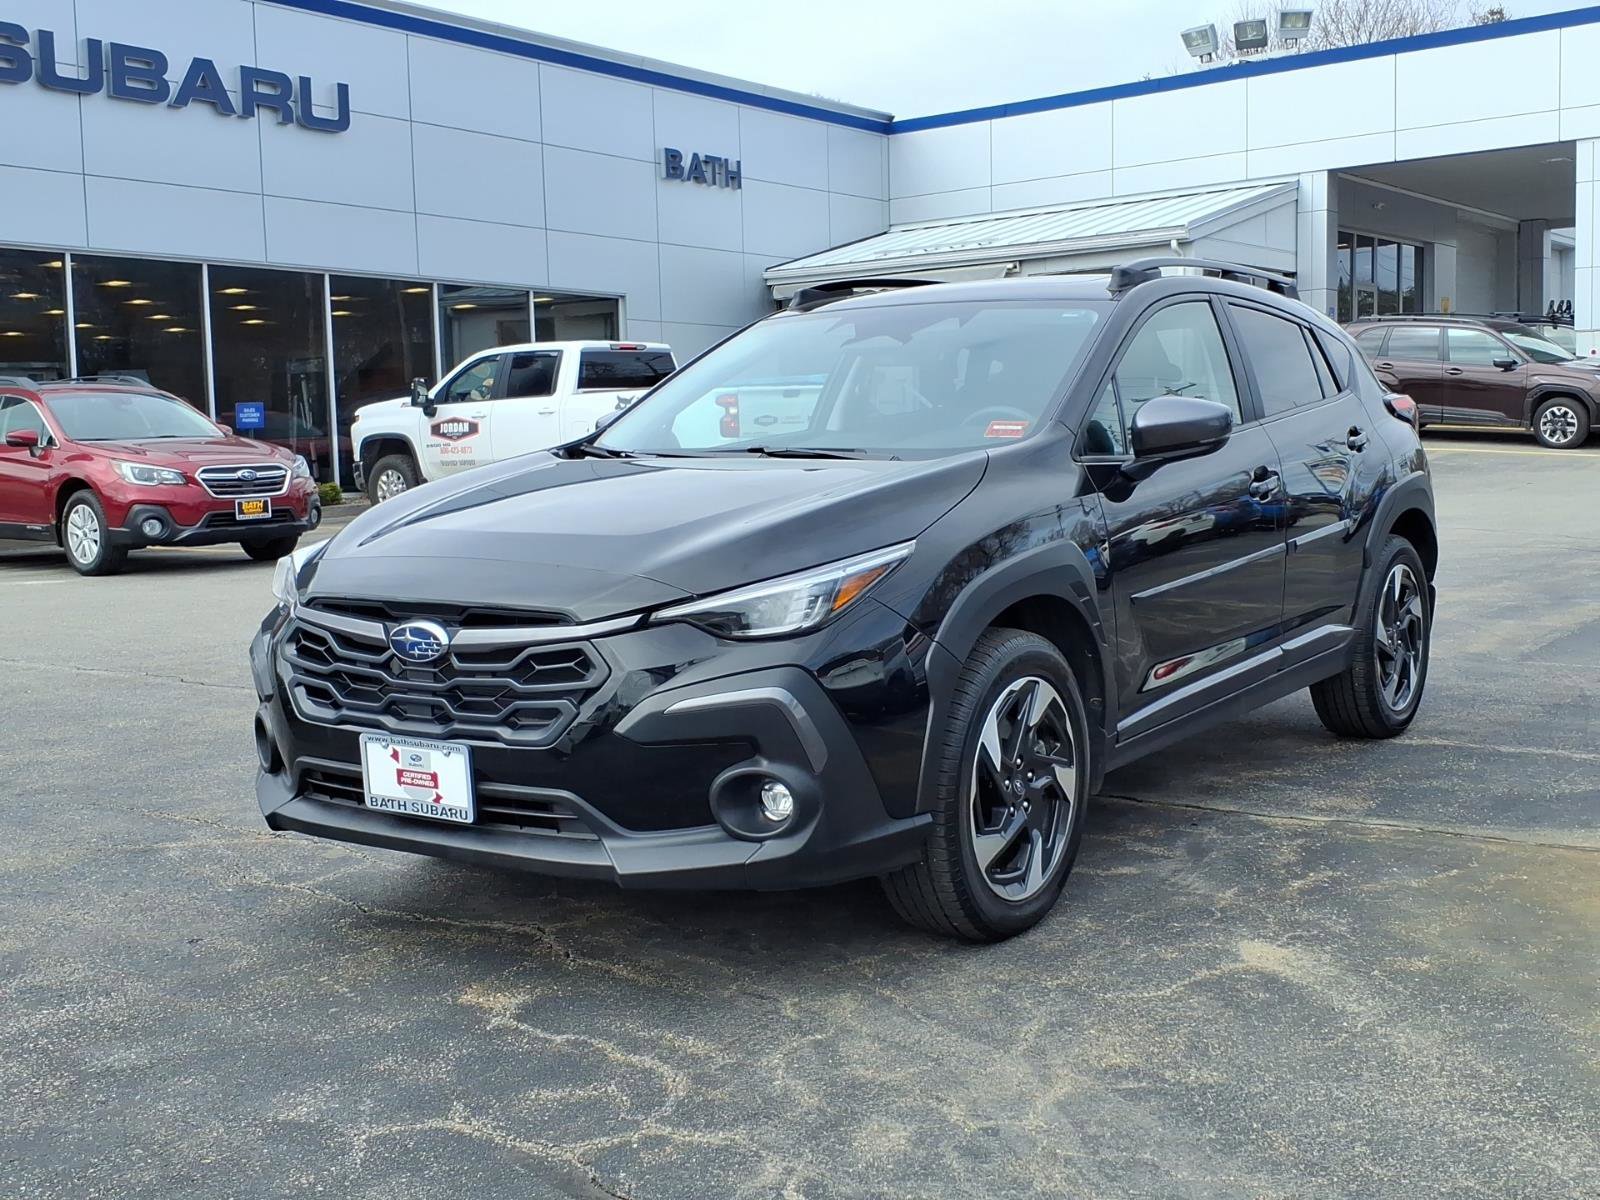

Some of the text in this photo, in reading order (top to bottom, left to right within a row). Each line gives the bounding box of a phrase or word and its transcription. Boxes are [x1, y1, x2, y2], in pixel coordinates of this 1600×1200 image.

[0, 20, 350, 133] SUBARU
[664, 147, 742, 189] BATH
[440, 422, 469, 434] JORDAN
[367, 735, 461, 753] www.bathsubaru.com
[400, 777, 435, 788] PRE-OWNED
[402, 770, 432, 781] CERTIFIED
[370, 796, 469, 821] BATH SUBARU
